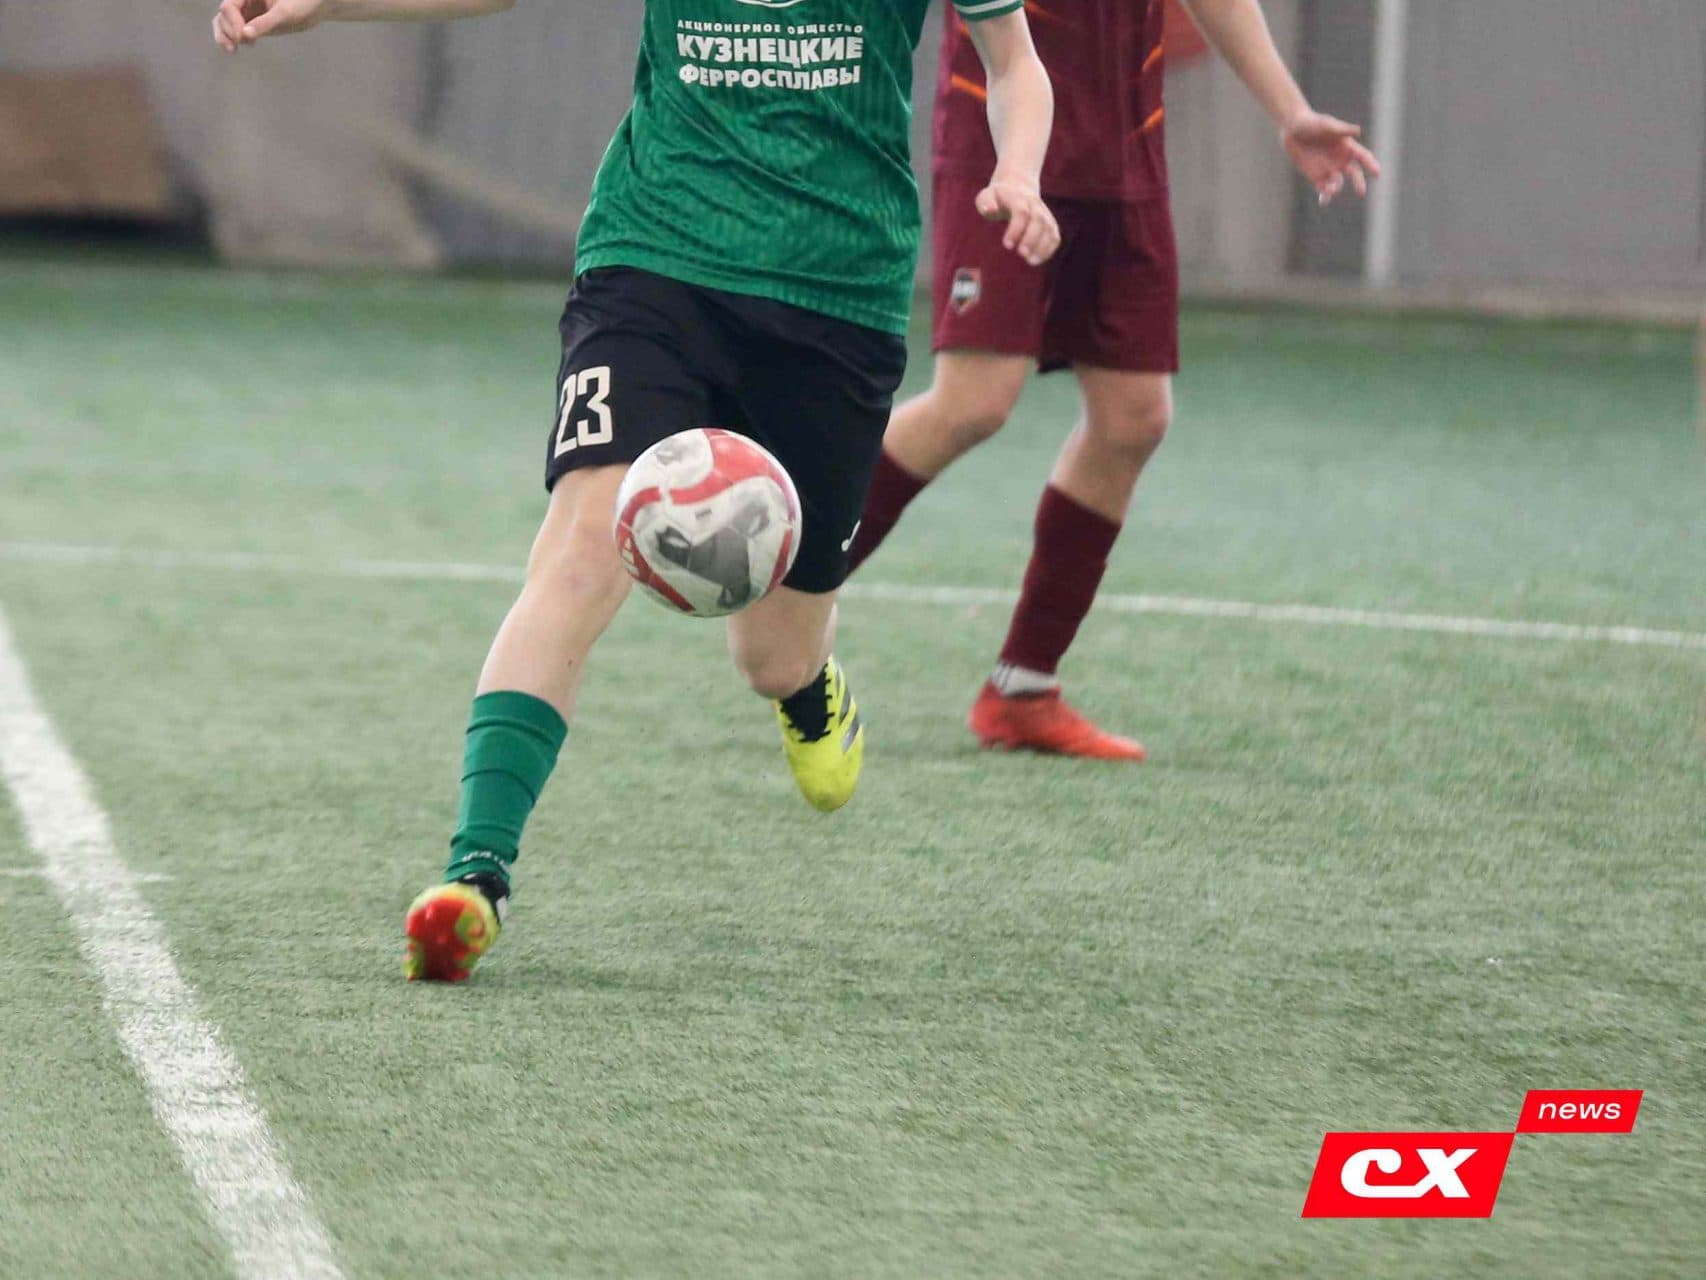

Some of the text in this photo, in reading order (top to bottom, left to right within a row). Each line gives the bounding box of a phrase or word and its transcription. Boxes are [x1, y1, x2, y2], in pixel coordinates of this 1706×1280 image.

[677, 20, 864, 35] АКЦИОНЕРНОЕ ОБЩЕСТВО
[676, 33, 864, 69] КУЗНЕЦКИЕ
[678, 63, 861, 90] ФЕРРОСПЛАВЫ
[554, 365, 613, 459] 23
